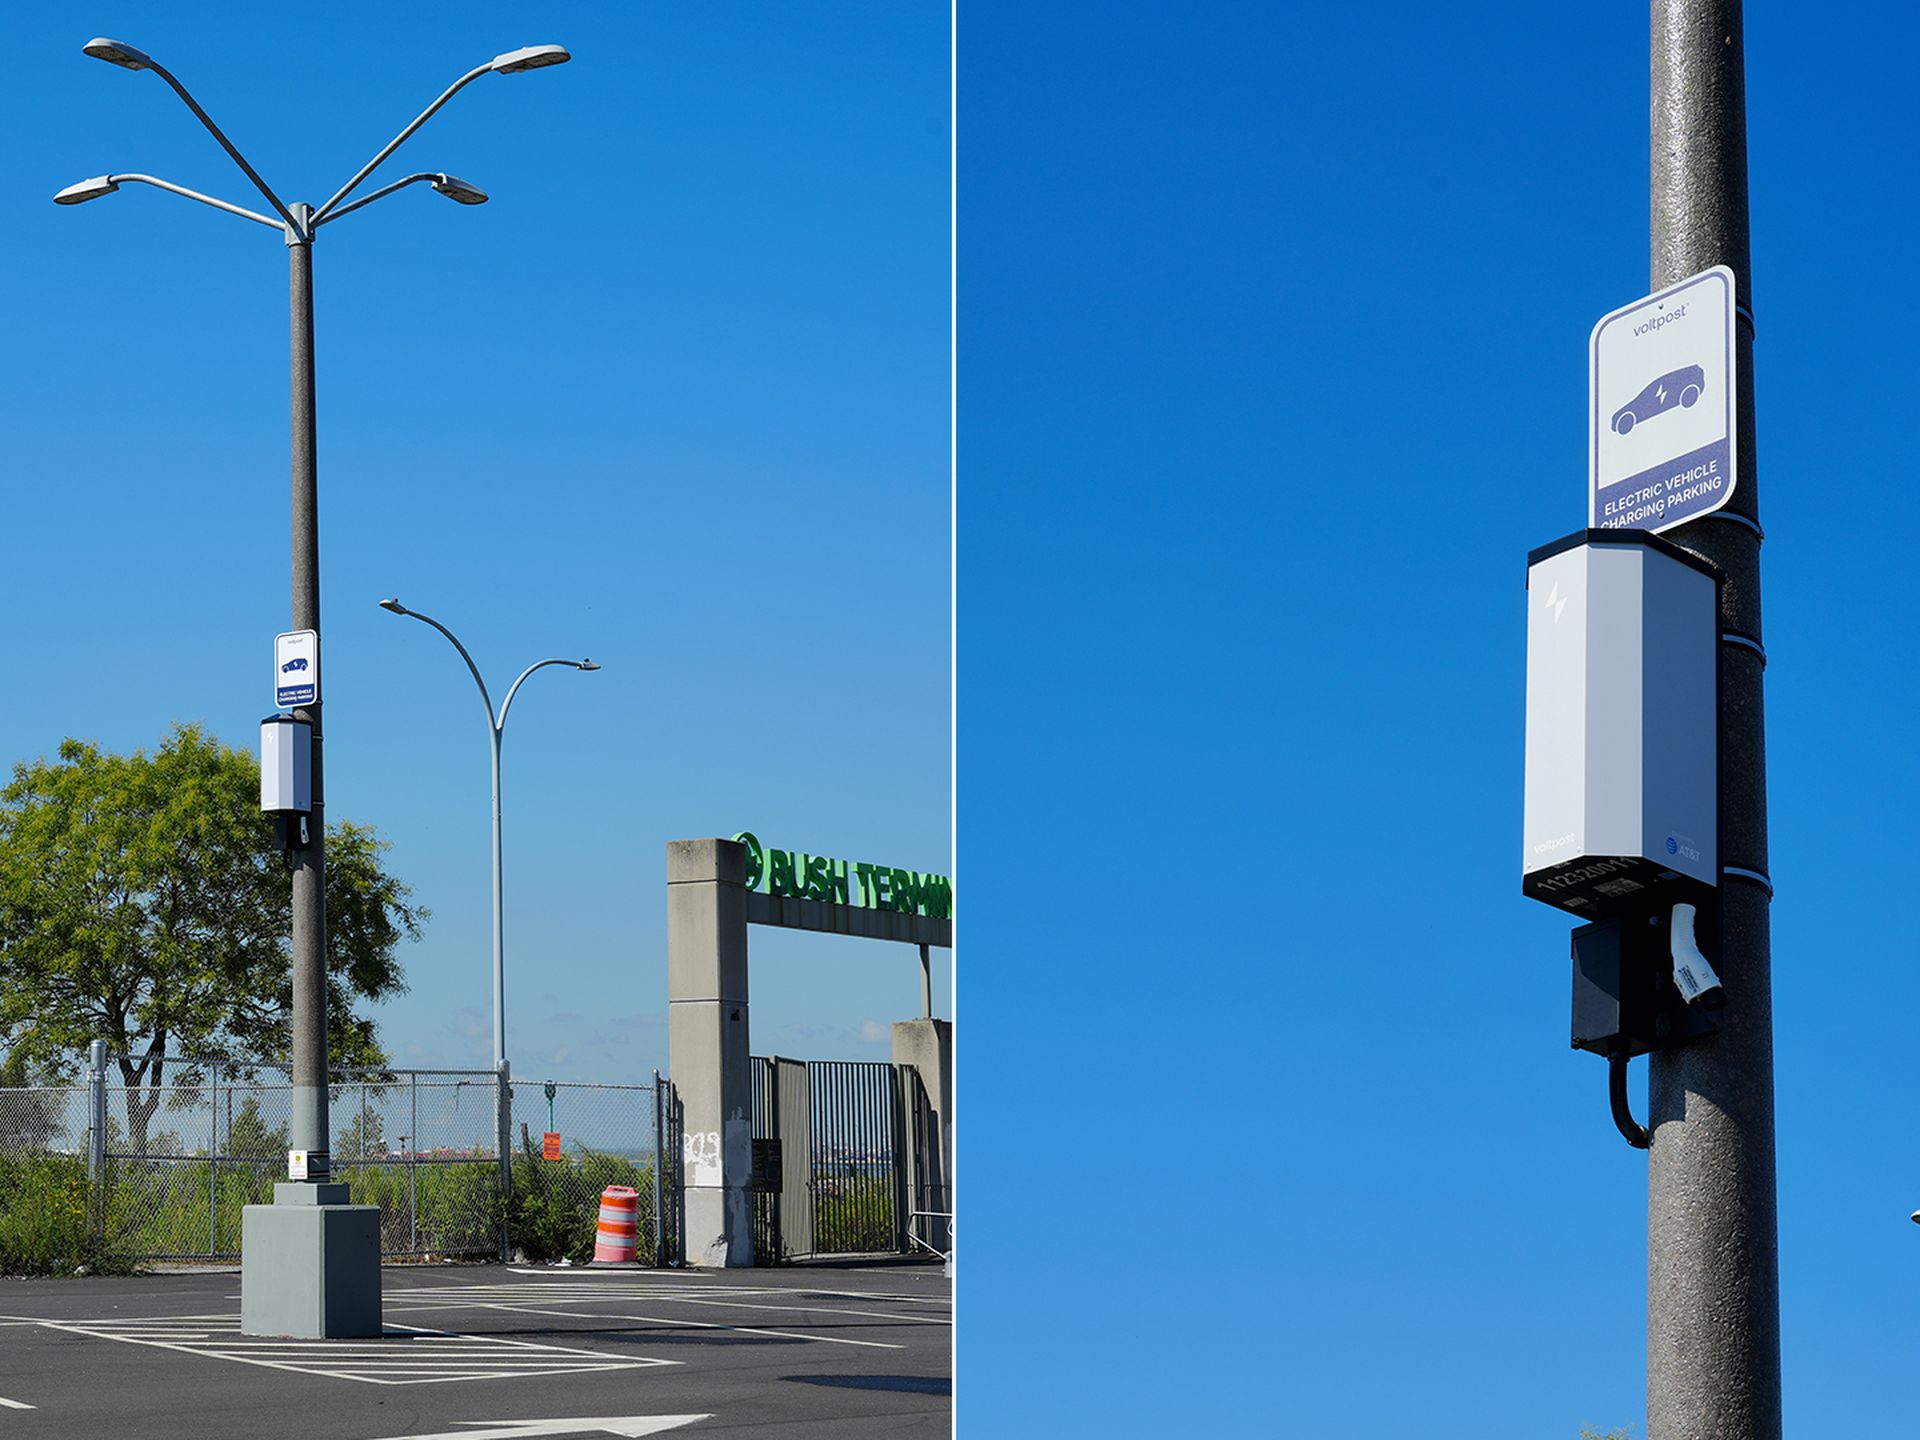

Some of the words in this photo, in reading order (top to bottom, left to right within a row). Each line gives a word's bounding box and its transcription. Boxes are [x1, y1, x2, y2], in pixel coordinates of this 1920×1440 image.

[1633, 304, 1686, 337] voltpost
[1600, 499, 1665, 529] CHARGING
[1667, 476, 1722, 508] PARKING
[1604, 483, 1662, 516] ELECTRIC
[1664, 460, 1717, 492] VEHICLE
[764, 848, 849, 905] BUSH
